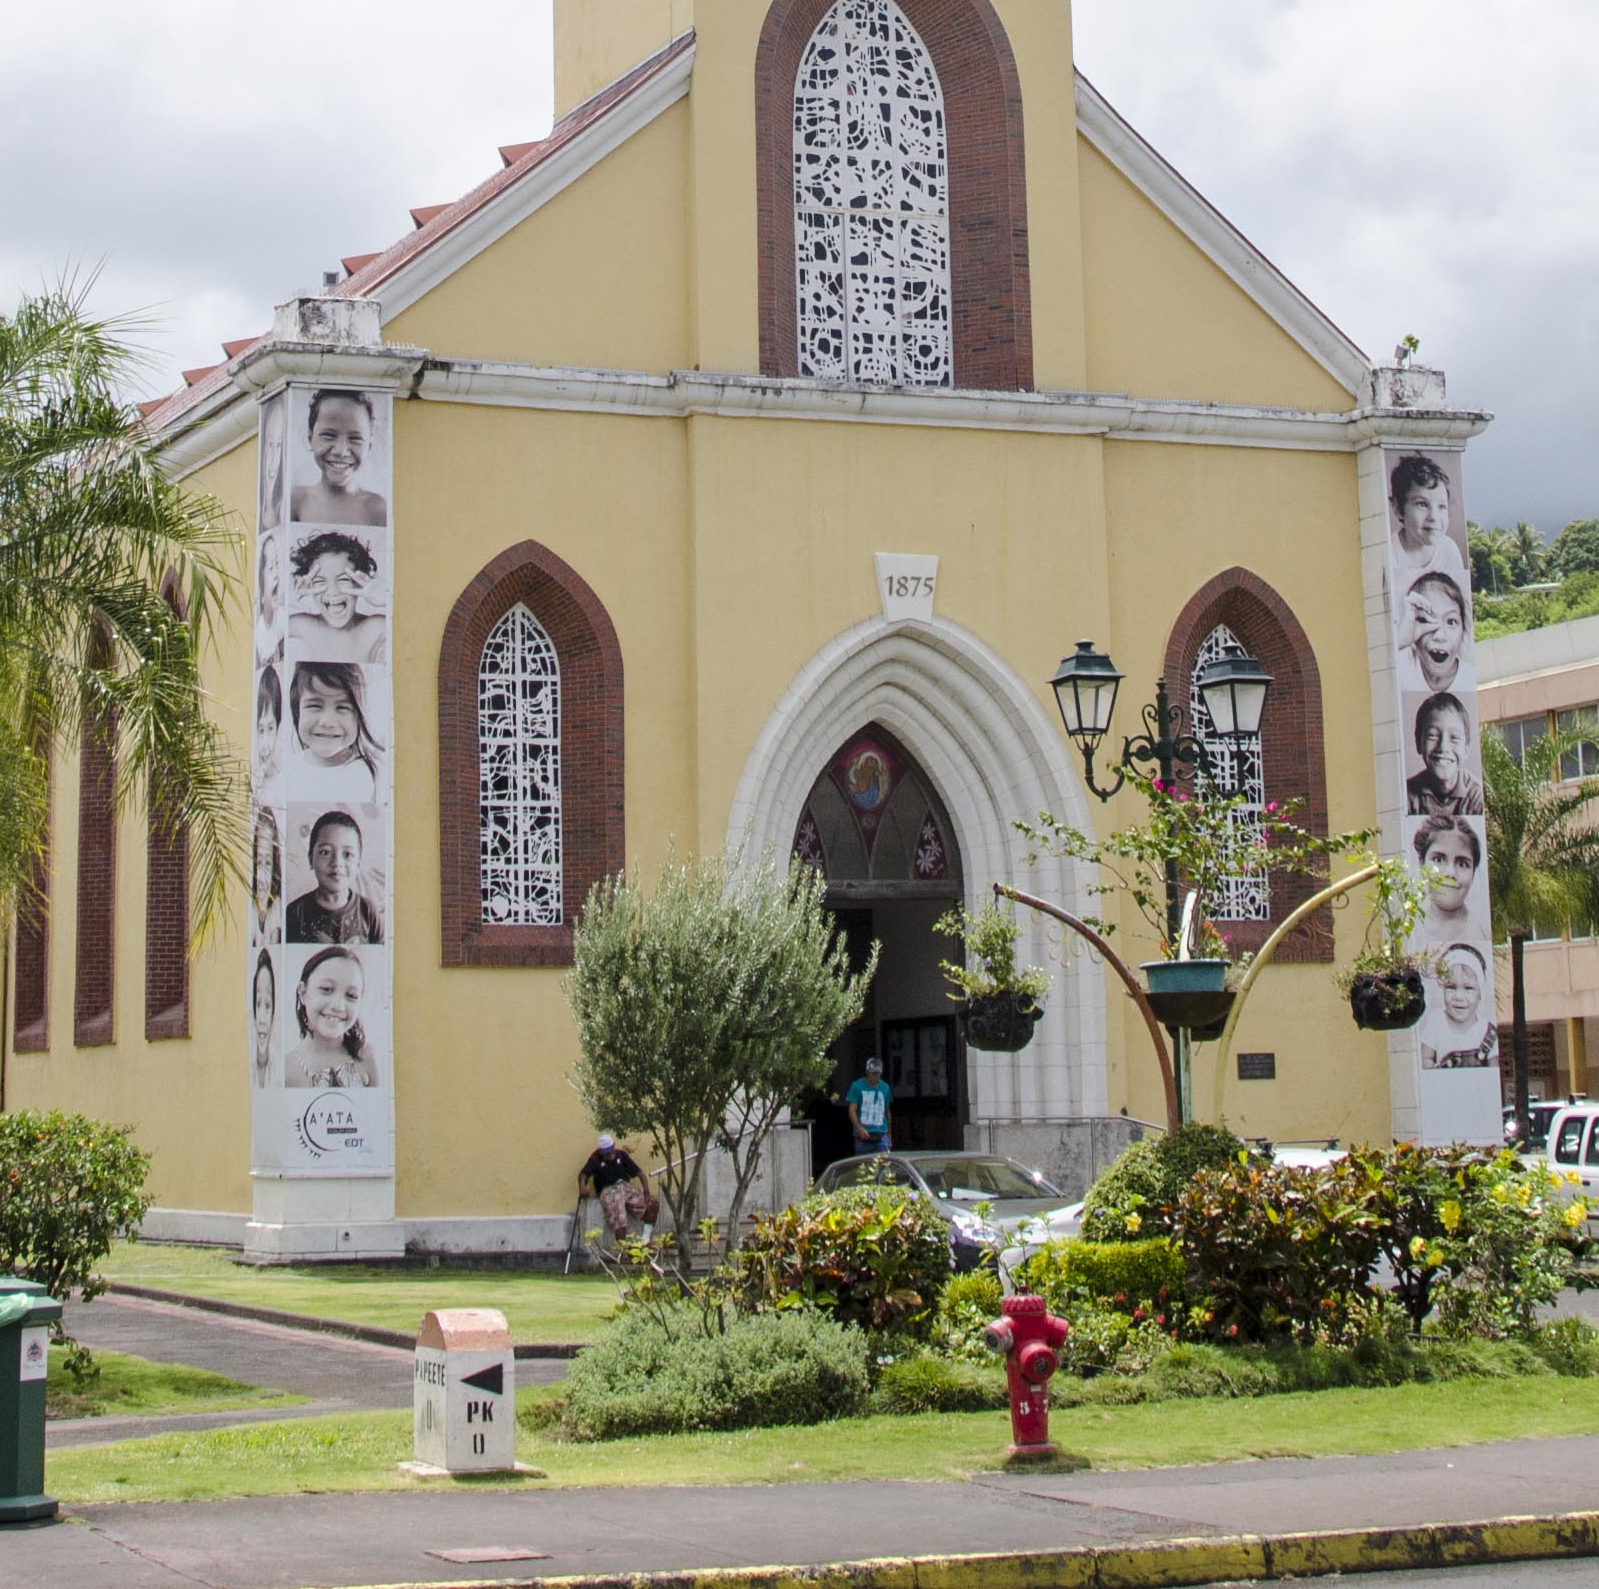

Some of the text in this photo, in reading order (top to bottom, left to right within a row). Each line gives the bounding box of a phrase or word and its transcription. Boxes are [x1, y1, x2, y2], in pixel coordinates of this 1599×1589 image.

[884, 575, 934, 597] 1875
[344, 1138, 365, 1148] EDT
[467, 1400, 494, 1423] PK
